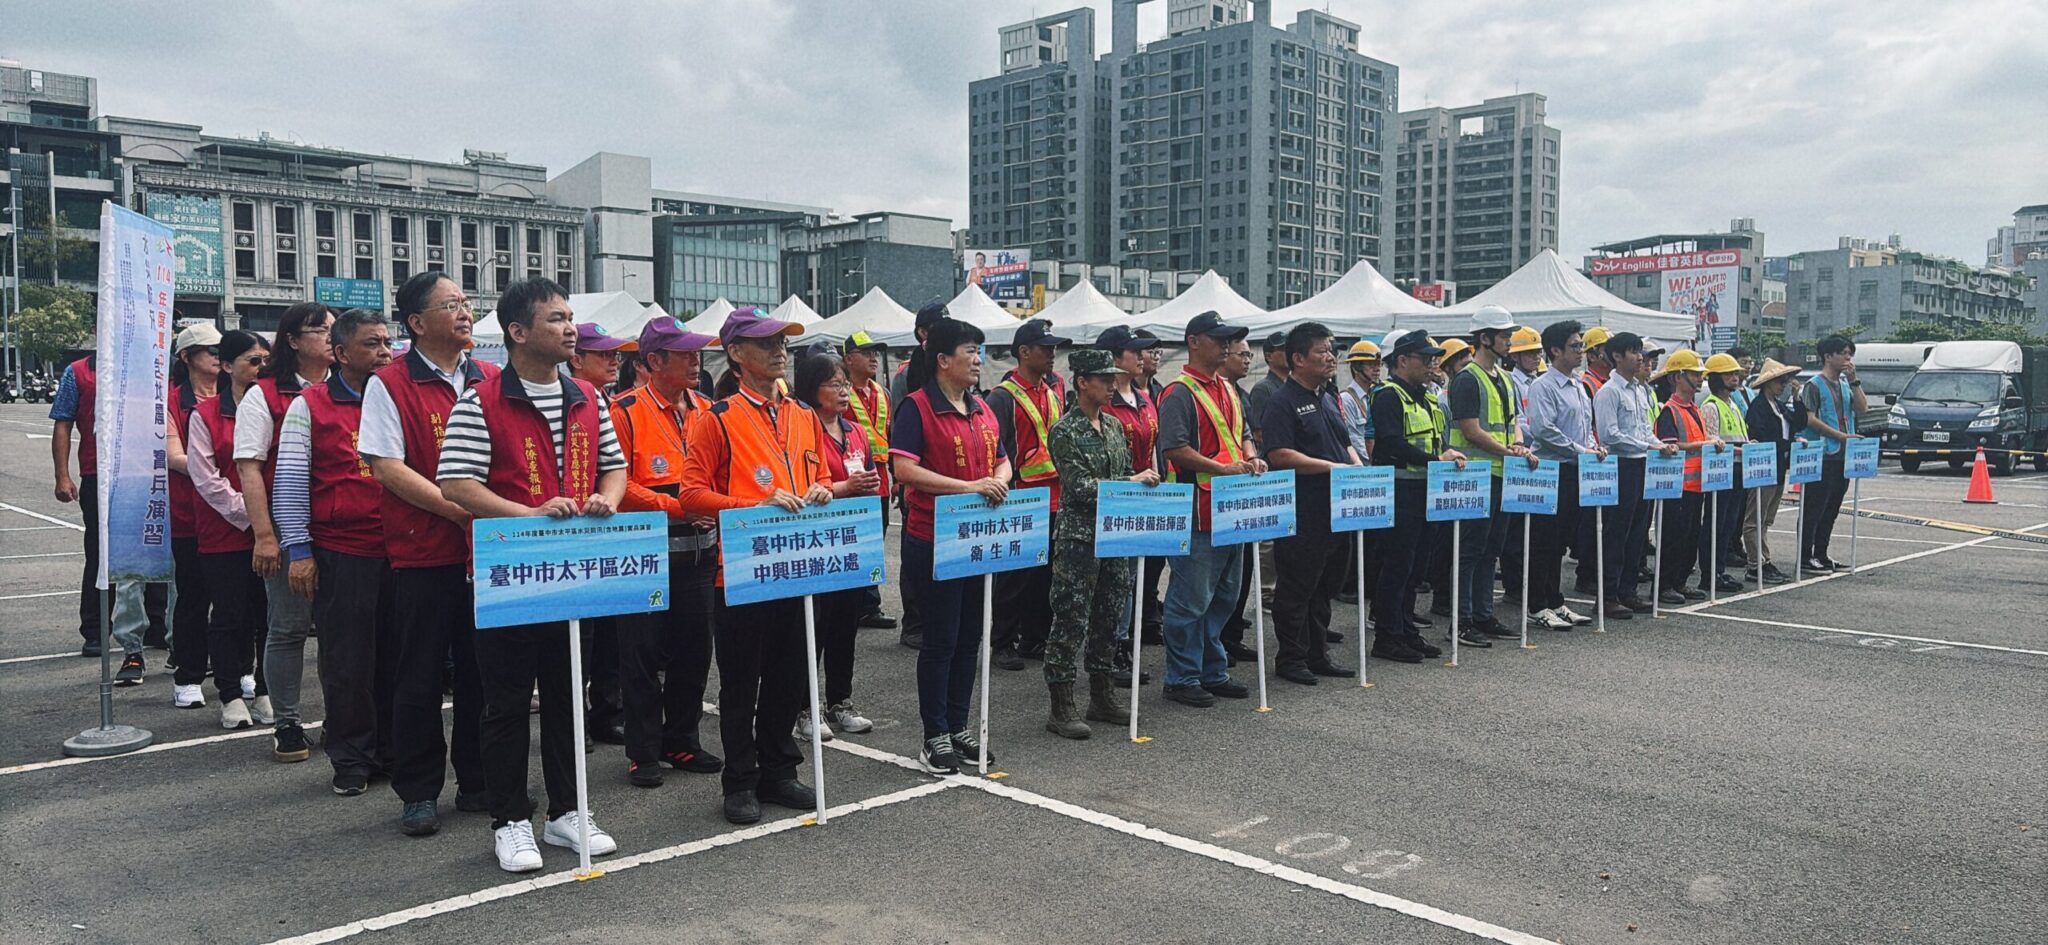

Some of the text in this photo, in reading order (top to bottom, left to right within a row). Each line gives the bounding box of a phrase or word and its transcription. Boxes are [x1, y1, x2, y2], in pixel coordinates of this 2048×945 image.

[1622, 260, 1655, 272] English
[1657, 254, 1704, 268] 佳音英語
[174, 284, 221, 292] 4-23927333
[1668, 276, 1692, 293] WE
[1694, 273, 1719, 288] ADAPT
[1719, 272, 1727, 281] TO
[1707, 282, 1727, 296] NEEDS
[1341, 487, 1387, 500] 臺中市政府消防局
[1443, 479, 1478, 493] 臺中市政府
[1216, 493, 1293, 513] 臺中市政府環境保護局
[1435, 496, 1484, 511] 警察局太平分局
[957, 514, 1033, 541] 臺中市太平區
[1102, 515, 1187, 532] 臺中市後備指揮部
[1233, 514, 1279, 532] 太平區清潔隊
[752, 525, 858, 557] 臺中市太平區
[970, 540, 1021, 563] 衛生所
[489, 553, 660, 588] 臺中市太平區公所
[753, 552, 860, 585] 中興里辦公處
